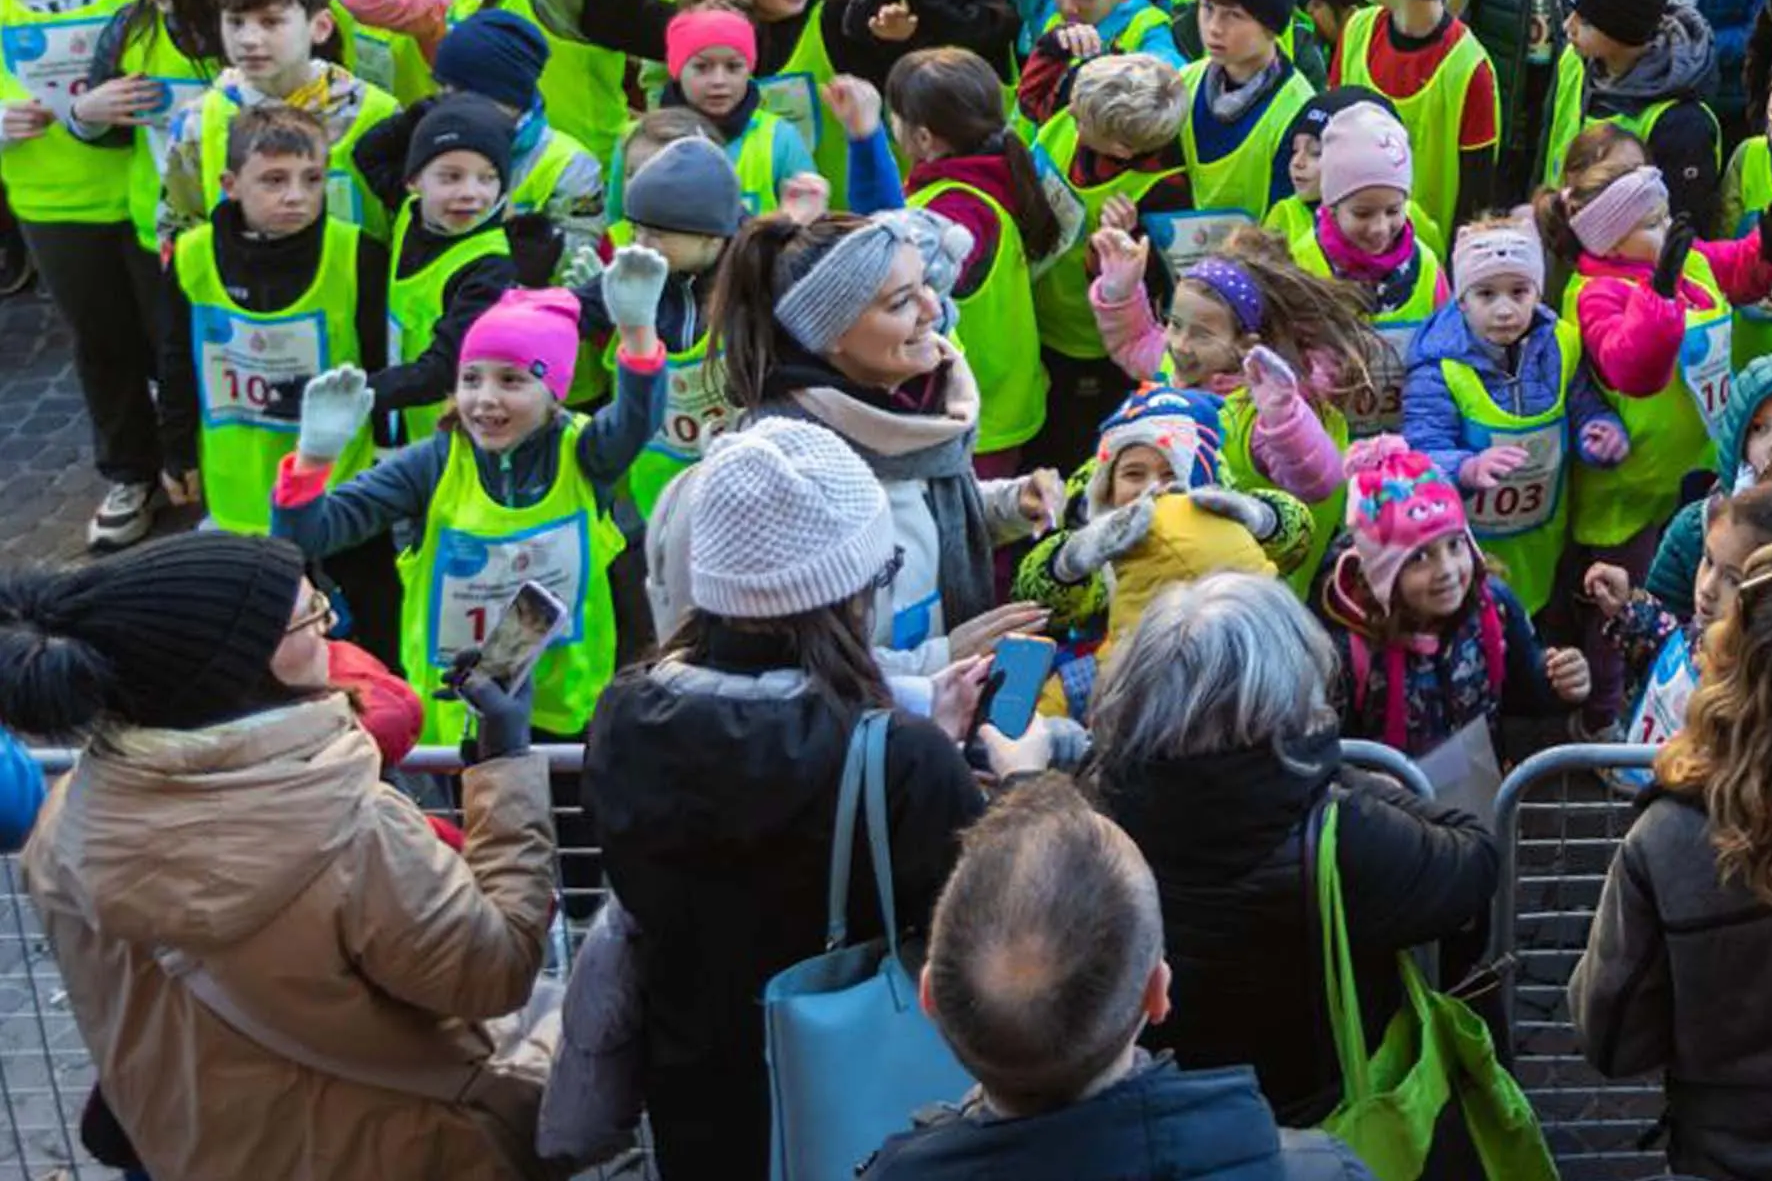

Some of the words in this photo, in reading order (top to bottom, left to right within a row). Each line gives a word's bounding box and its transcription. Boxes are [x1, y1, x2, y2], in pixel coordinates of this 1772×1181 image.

[222, 369, 269, 406] 10
[1354, 385, 1402, 416] 03
[1703, 373, 1729, 413] 10
[1471, 483, 1544, 517] 103
